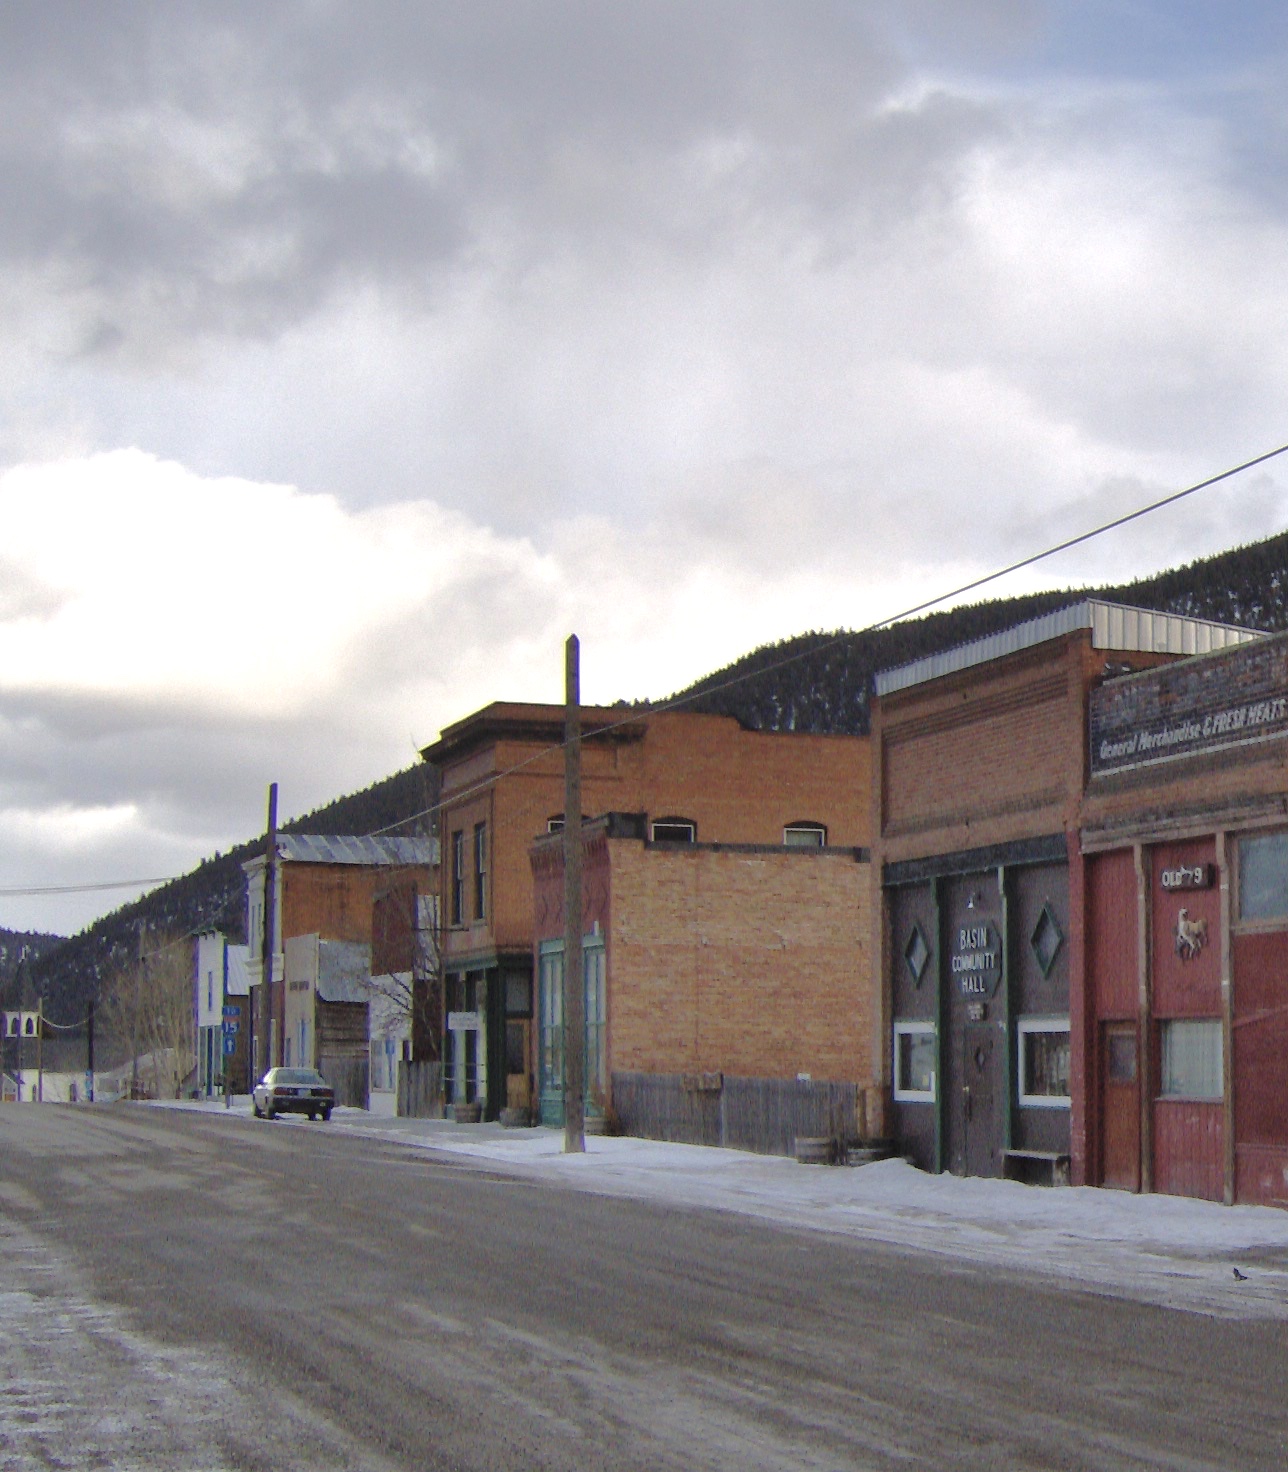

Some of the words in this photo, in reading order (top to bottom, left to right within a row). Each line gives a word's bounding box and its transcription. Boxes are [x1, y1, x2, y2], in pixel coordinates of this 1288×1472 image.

[1100, 734, 1137, 760] General
[1139, 722, 1201, 751] Merchandise
[1202, 716, 1213, 737] &
[1213, 706, 1246, 733] FRESH
[1247, 699, 1286, 726] MEATS
[960, 927, 987, 950] BASIN
[952, 952, 995, 973] COMMUNITY
[962, 975, 985, 993] HALL
